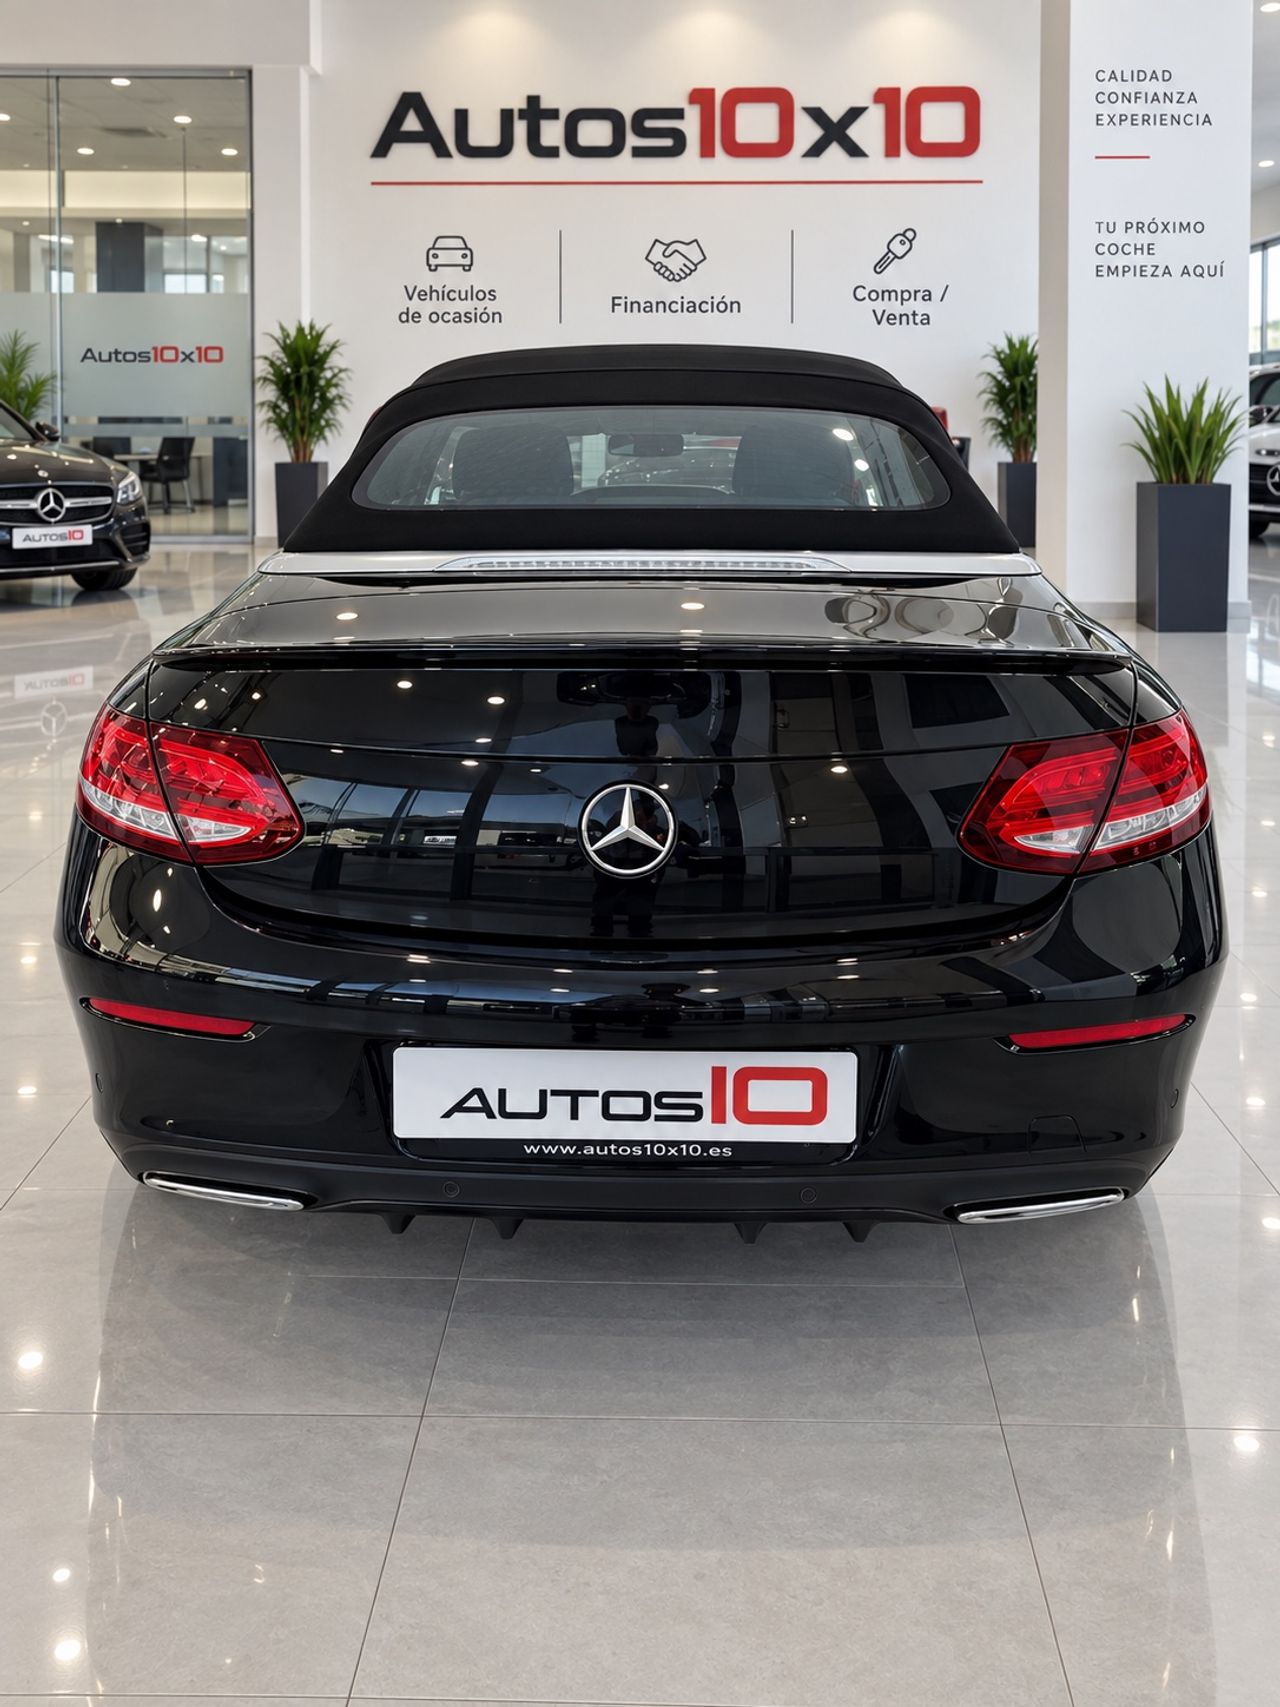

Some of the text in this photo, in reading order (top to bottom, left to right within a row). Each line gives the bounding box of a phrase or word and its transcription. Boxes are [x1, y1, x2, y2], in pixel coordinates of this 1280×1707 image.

[1095, 69, 1173, 83] CALIDAD
[1095, 91, 1198, 104] CONFIANZA
[370, 86, 982, 159] Autos10x10
[1095, 113, 1213, 127] EXPERIENCIA
[1095, 217, 1205, 235] TU PRÓXIMO
[1095, 243, 1156, 256] COCHE
[1095, 261, 1225, 279] EMPIEZA AQUÍ
[404, 284, 497, 302] Vehículos
[853, 285, 932, 306] Compra
[611, 294, 741, 314] Financiación
[398, 306, 503, 324] de ocasión
[872, 308, 930, 326] Venta
[81, 346, 223, 363] Autos10x10
[22, 529, 84, 543] AUTOS10
[440, 1066, 828, 1126] AUTOS10
[523, 1142, 733, 1158] www.autos10x10.es
